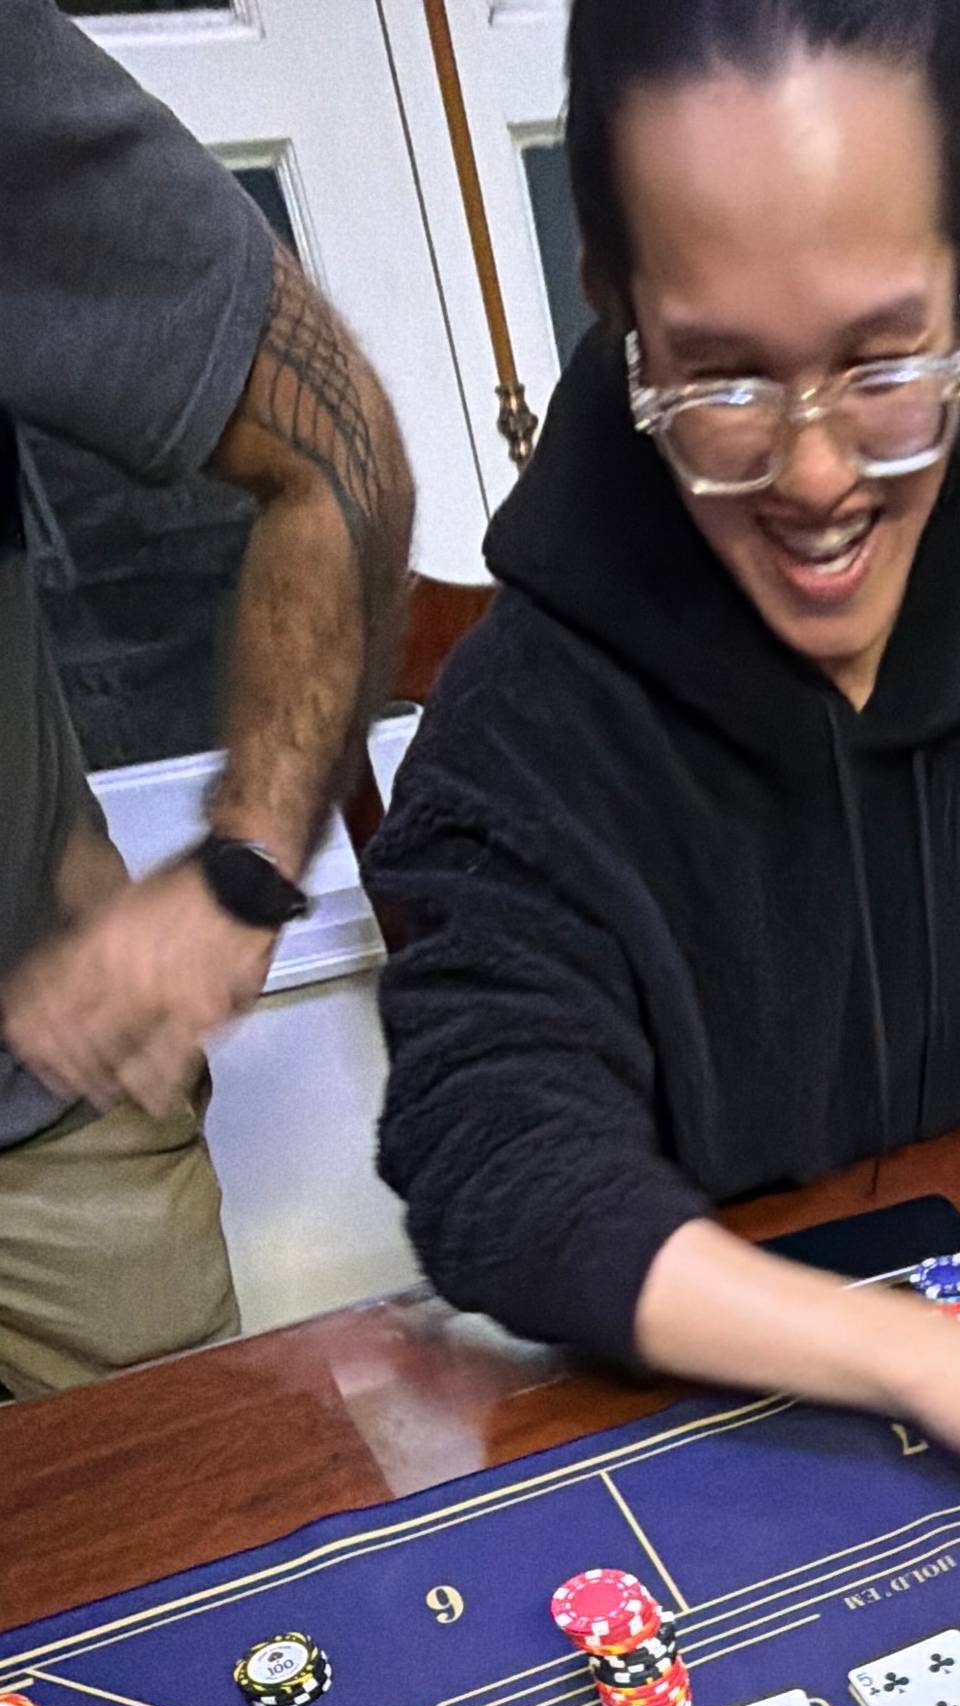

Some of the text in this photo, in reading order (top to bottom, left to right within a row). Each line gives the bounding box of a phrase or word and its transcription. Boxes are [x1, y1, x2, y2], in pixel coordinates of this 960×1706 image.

[843, 1554, 957, 1610] HOLD'EM
[267, 1659, 295, 1677] 100
[856, 1672, 873, 1688] 5
